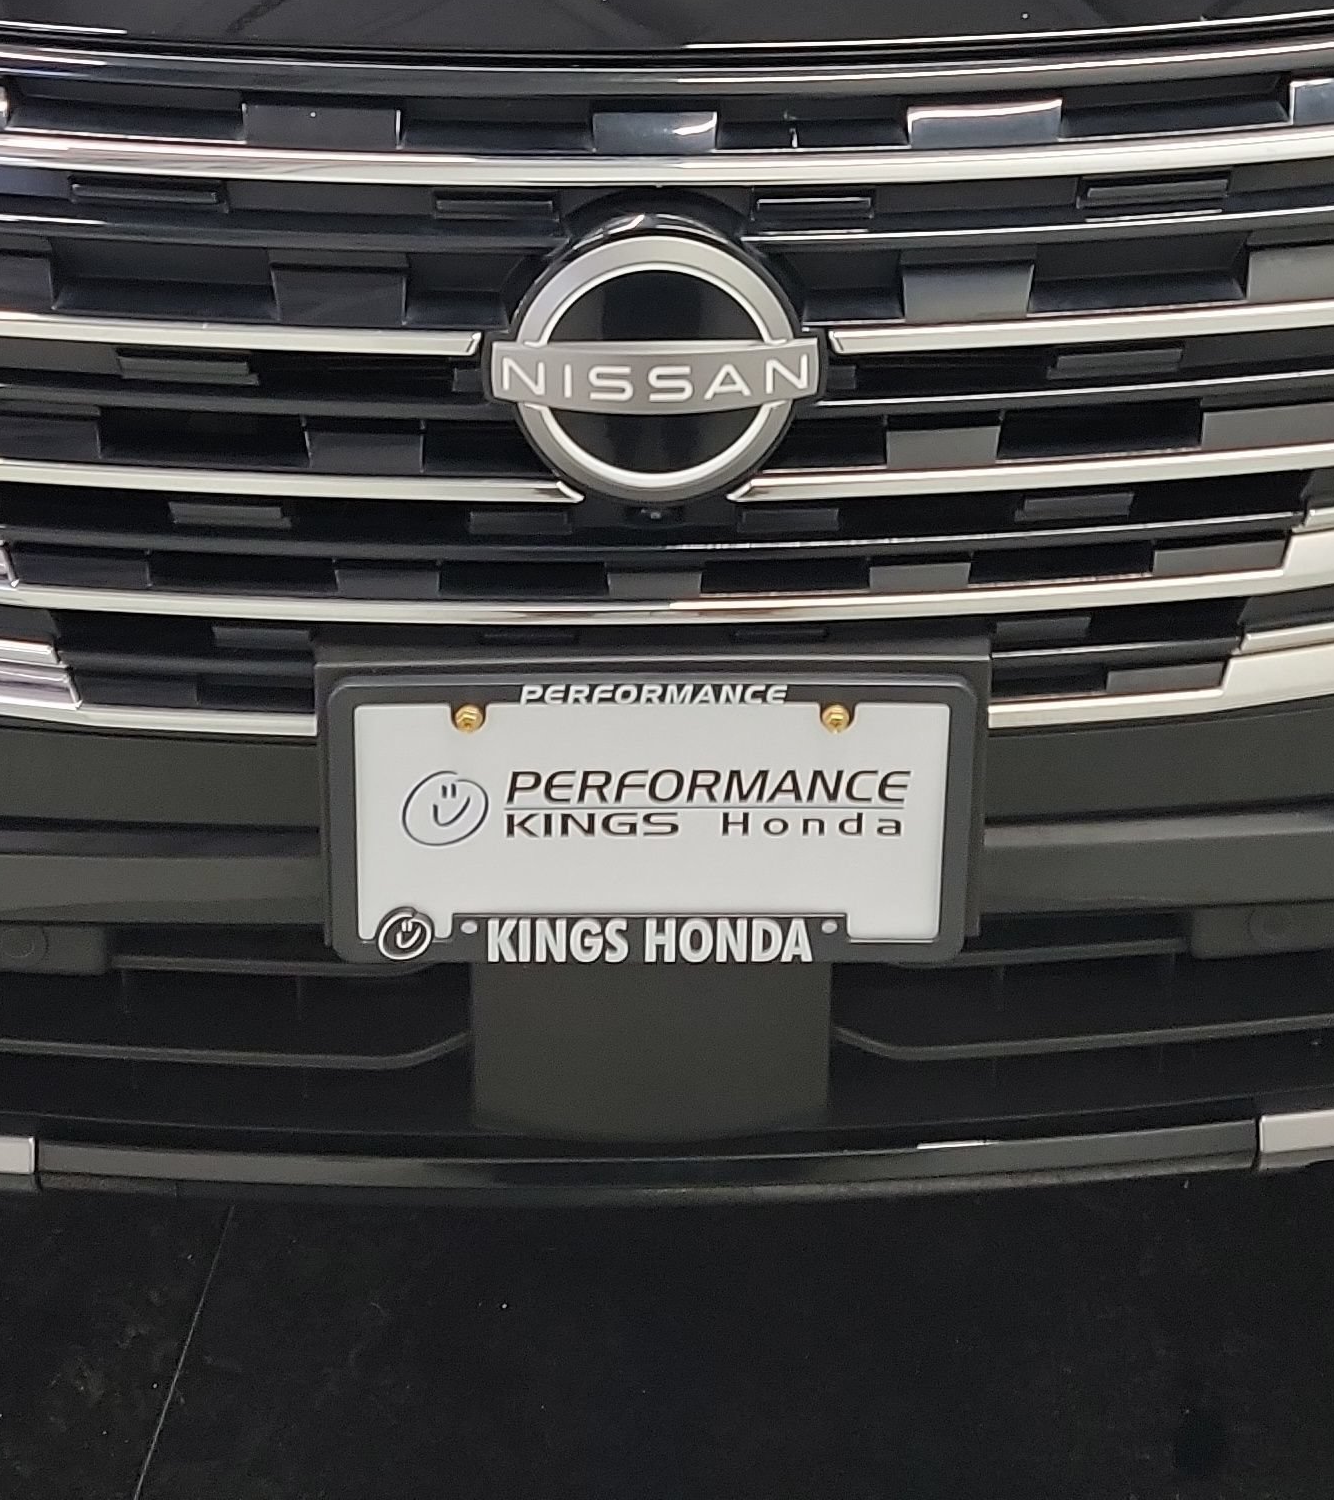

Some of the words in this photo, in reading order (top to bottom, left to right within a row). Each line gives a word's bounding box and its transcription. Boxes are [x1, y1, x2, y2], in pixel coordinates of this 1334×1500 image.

[502, 354, 808, 403] NISSAN
[519, 684, 788, 706] PERFORMANCE
[506, 769, 912, 804] PERFORMANCE
[505, 812, 680, 839] KINGS
[720, 812, 903, 838] Honda
[487, 918, 629, 963] KINGS
[644, 917, 813, 963] HONDA
